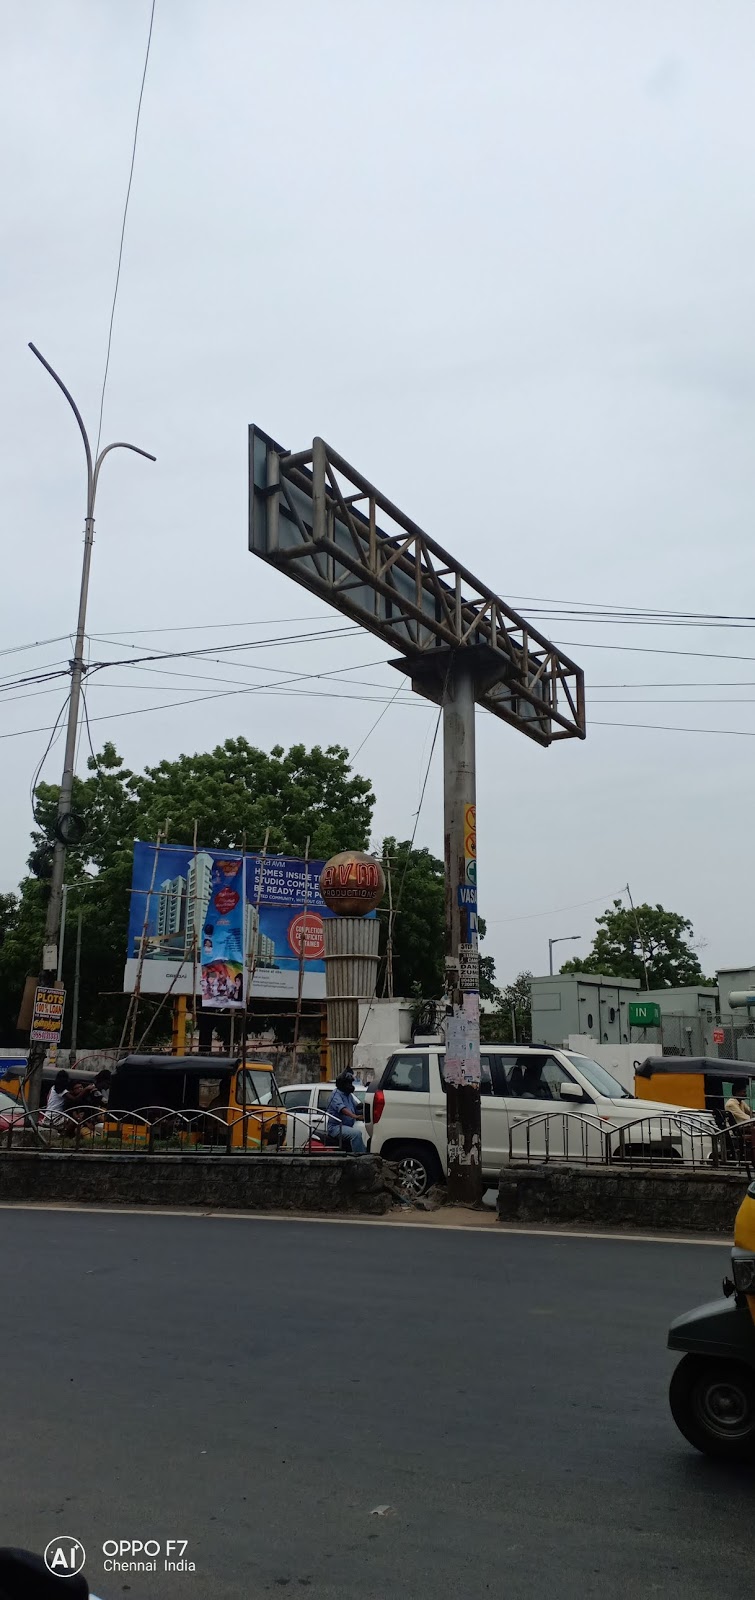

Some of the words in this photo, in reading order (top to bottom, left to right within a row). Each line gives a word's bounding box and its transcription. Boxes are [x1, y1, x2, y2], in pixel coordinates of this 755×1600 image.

[255, 868, 283, 877] HOMES
[286, 872, 312, 881] INSIDE
[324, 863, 378, 886] AVM
[255, 876, 284, 886] STUDIO
[267, 886, 294, 895] READY
[323, 890, 377, 898] PRODUCTIONS
[296, 933, 323, 941] CETIFICATE
[37, 993, 64, 1004] PLOTS
[37, 1003, 49, 1013] 100%
[50, 1004, 62, 1014] LOAN
[636, 1007, 646, 1016] IN
